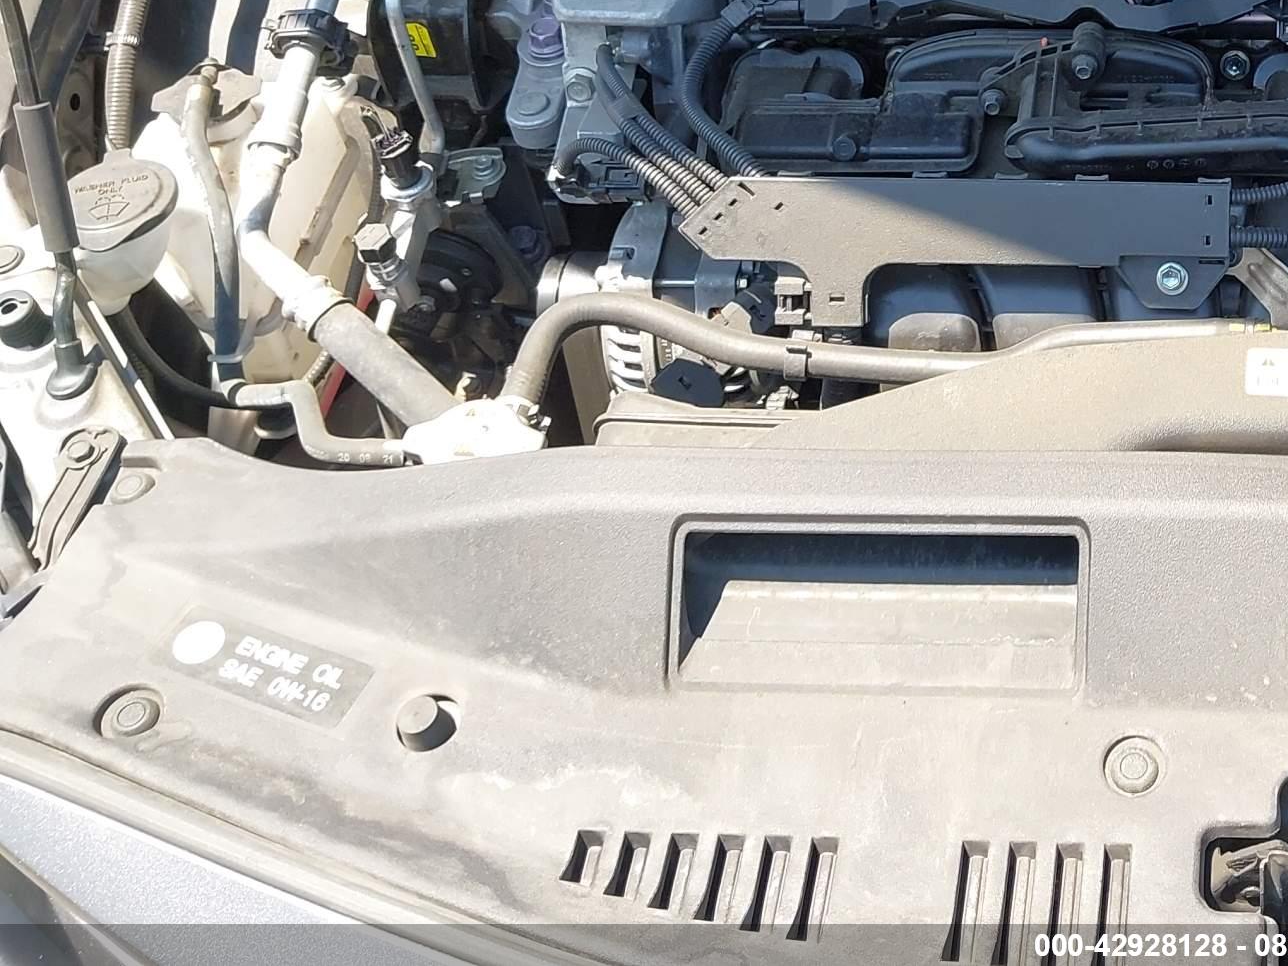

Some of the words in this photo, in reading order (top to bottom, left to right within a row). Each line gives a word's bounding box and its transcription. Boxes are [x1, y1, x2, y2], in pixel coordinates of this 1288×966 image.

[120, 174, 149, 184] FLUID
[218, 658, 264, 688] SAE
[267, 676, 331, 712] 0W-16
[235, 635, 309, 675] ENGINE
[312, 663, 344, 690] OIL
